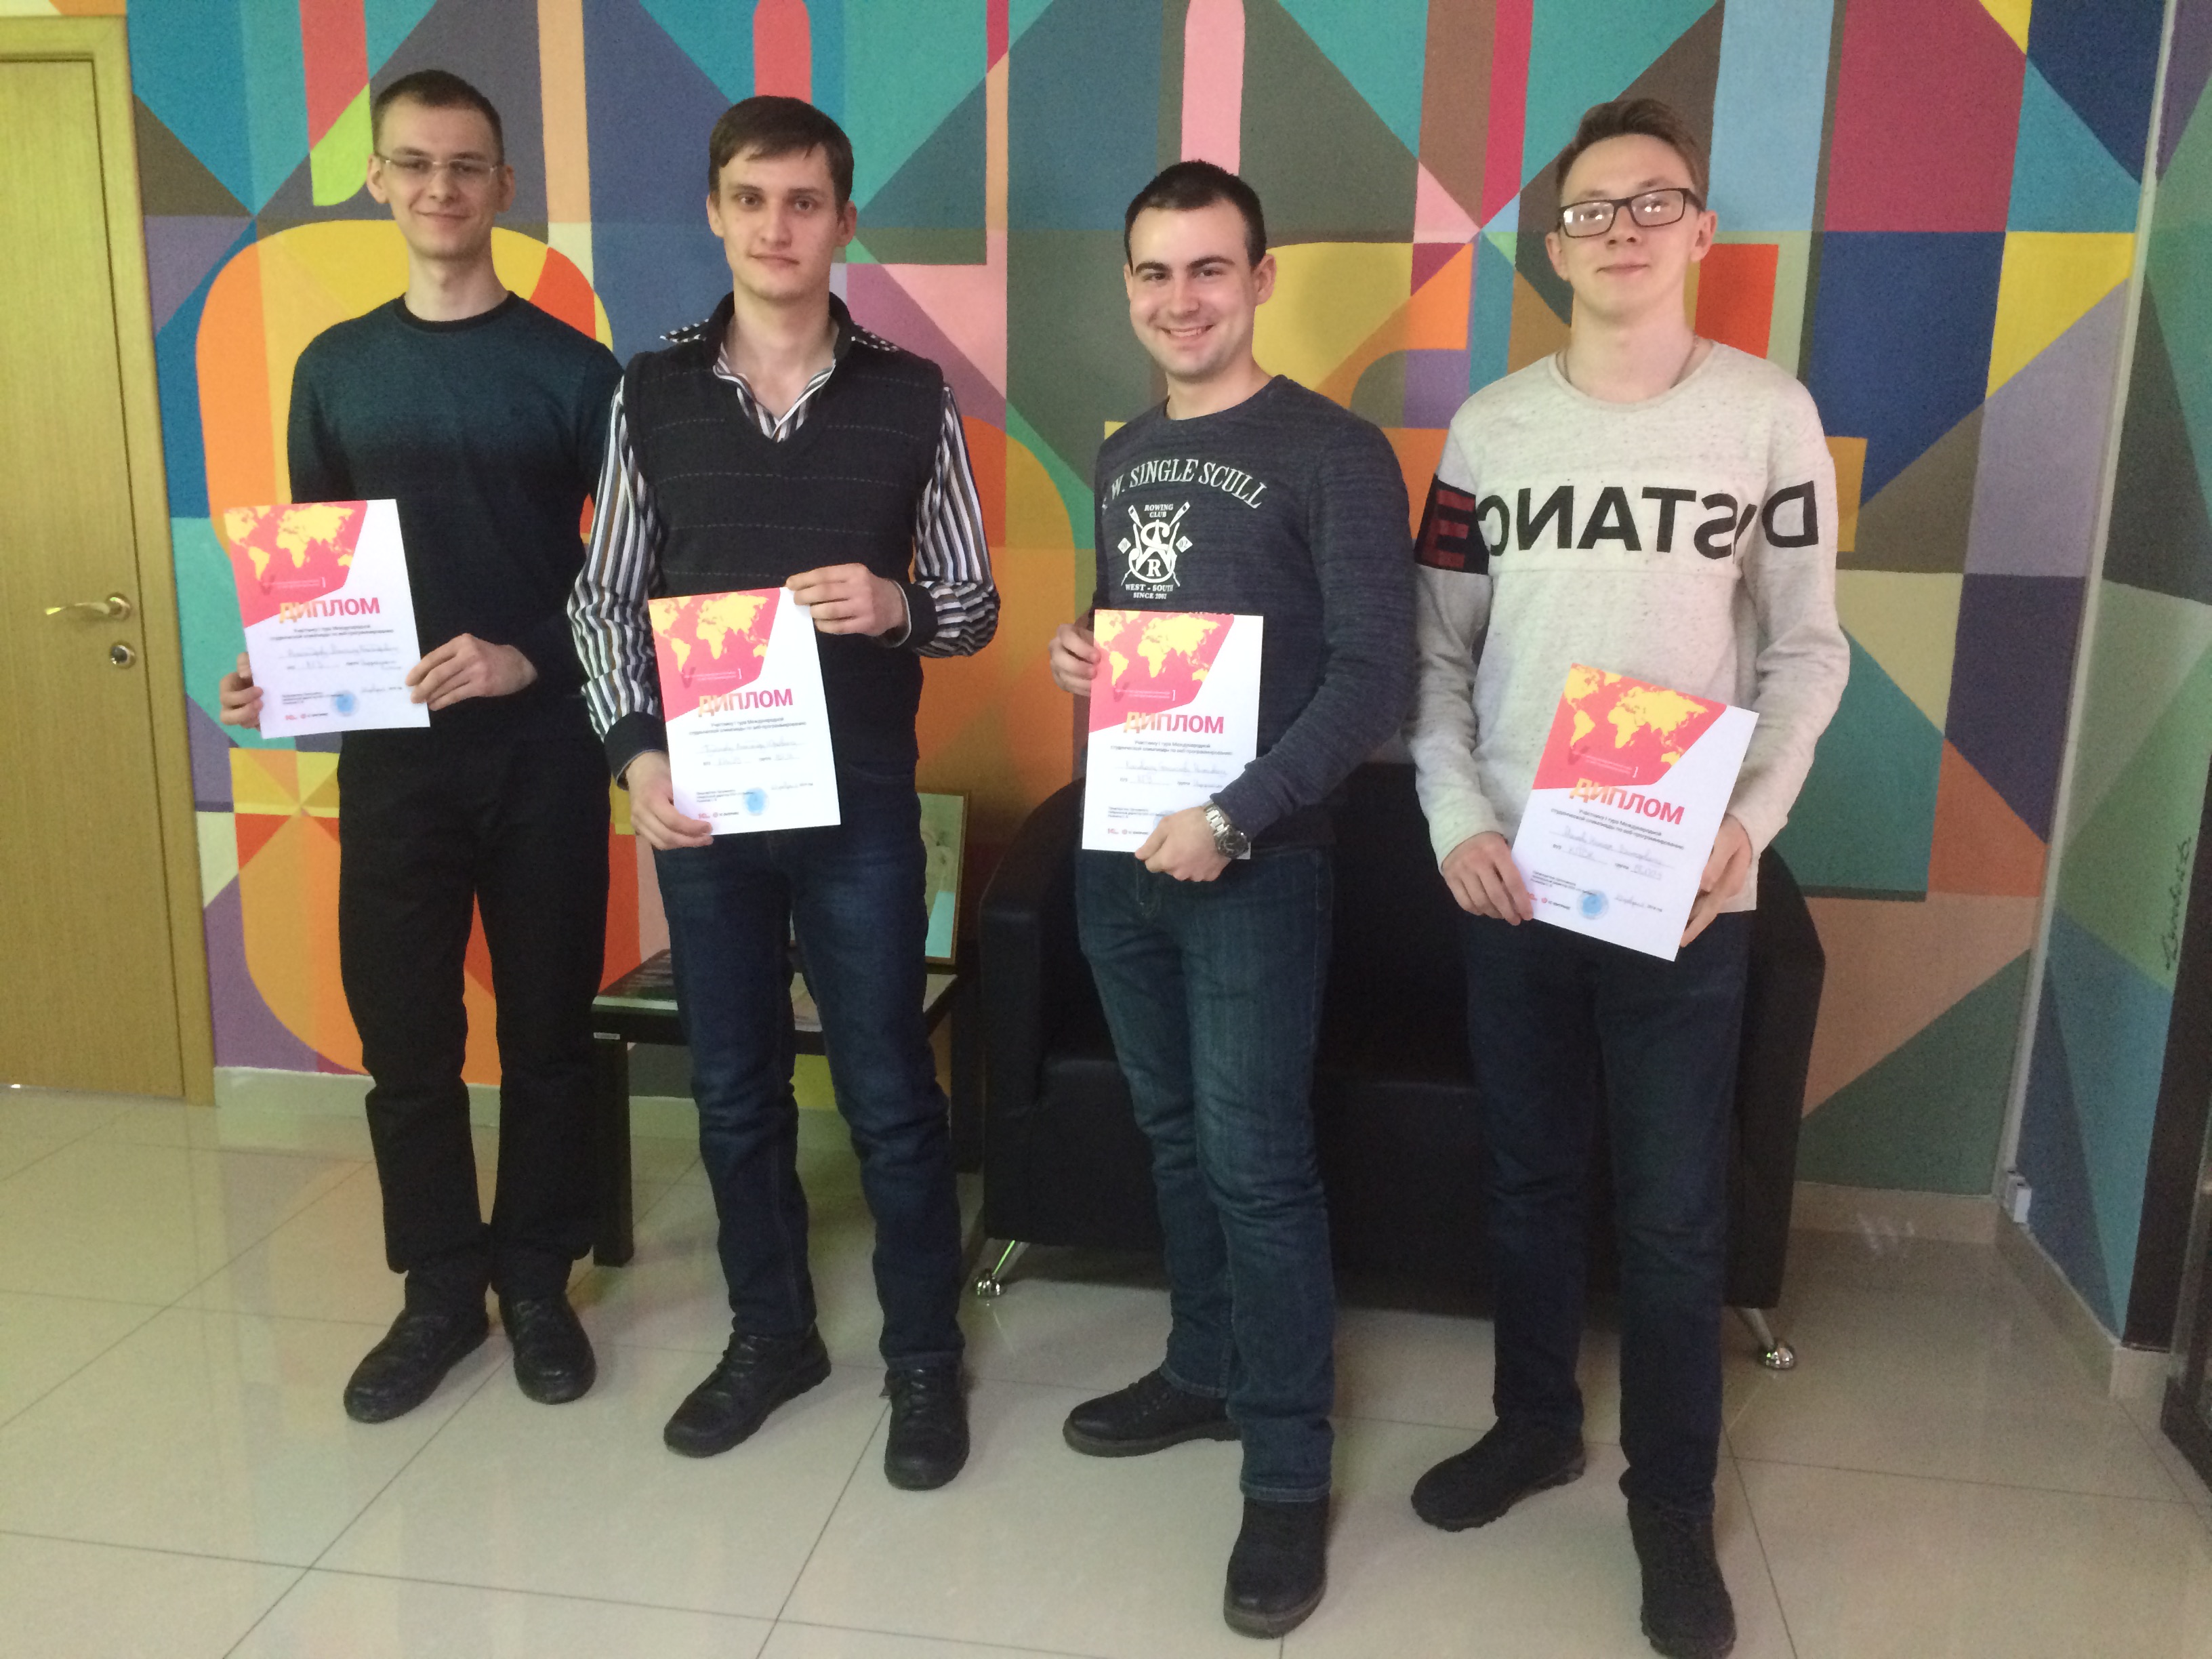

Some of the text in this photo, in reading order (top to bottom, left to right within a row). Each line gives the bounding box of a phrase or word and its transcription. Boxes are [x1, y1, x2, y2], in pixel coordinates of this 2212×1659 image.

[1129, 458, 1199, 488] SINGLE
[1198, 462, 1267, 509] SCULL
[1144, 504, 1174, 512] ROWING
[1125, 583, 1147, 592] WEST
[279, 597, 380, 623] ДИПЛОМ
[698, 689, 793, 718] ДИПЛОМ
[1123, 712, 1225, 734] ДИПЛОМ
[1569, 778, 1685, 825] ДИПЛОМ
